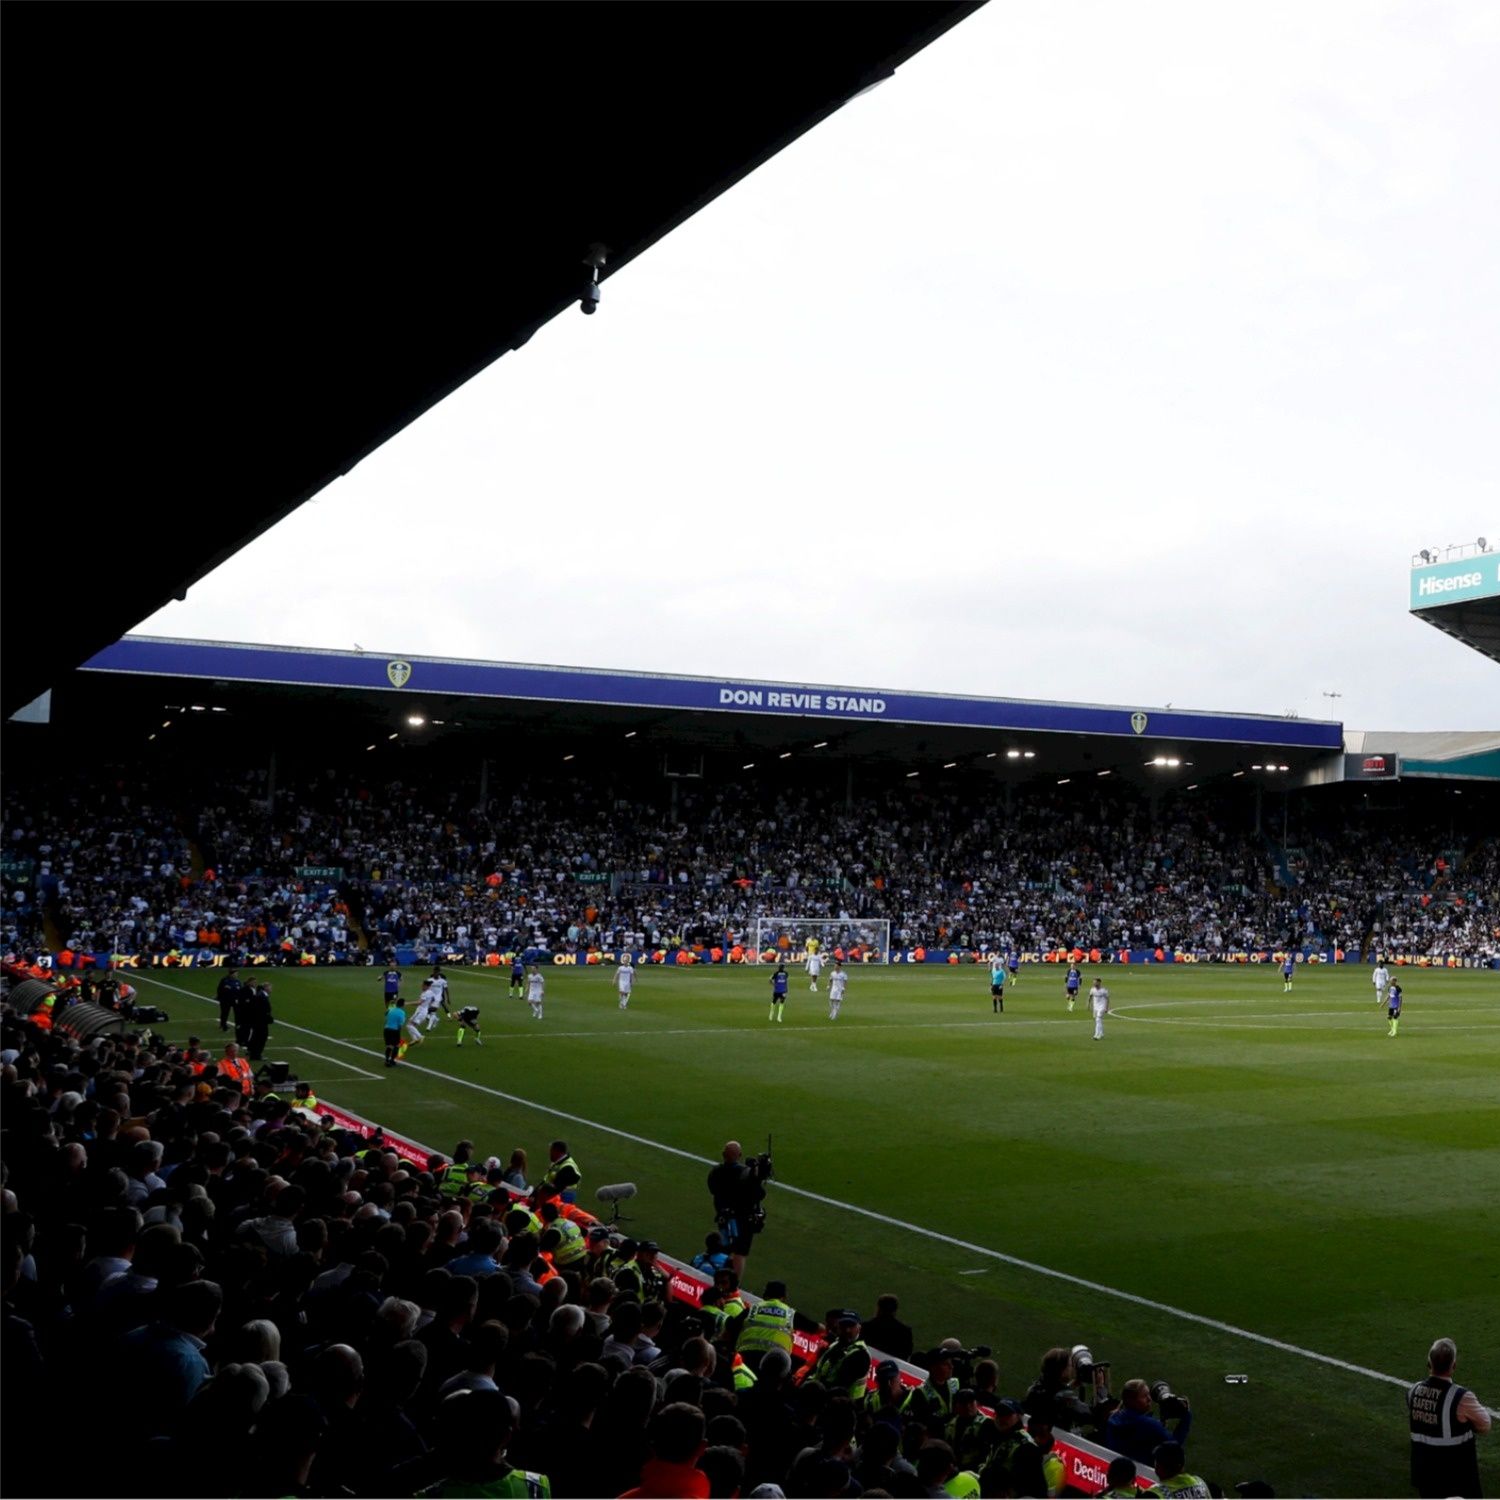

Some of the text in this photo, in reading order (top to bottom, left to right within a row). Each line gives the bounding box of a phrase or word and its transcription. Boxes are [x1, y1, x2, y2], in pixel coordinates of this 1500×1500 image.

[1419, 571, 1483, 596] Hisense
[720, 689, 887, 713] DON REVIE STAND
[554, 953, 576, 965] ON
[758, 1306, 785, 1317] POLICE
[1414, 1384, 1442, 1400] DEPUTY
[1412, 1396, 1439, 1413] SAFETY
[1412, 1408, 1439, 1425] OFFICER
[1073, 1457, 1110, 1489] Dealin
